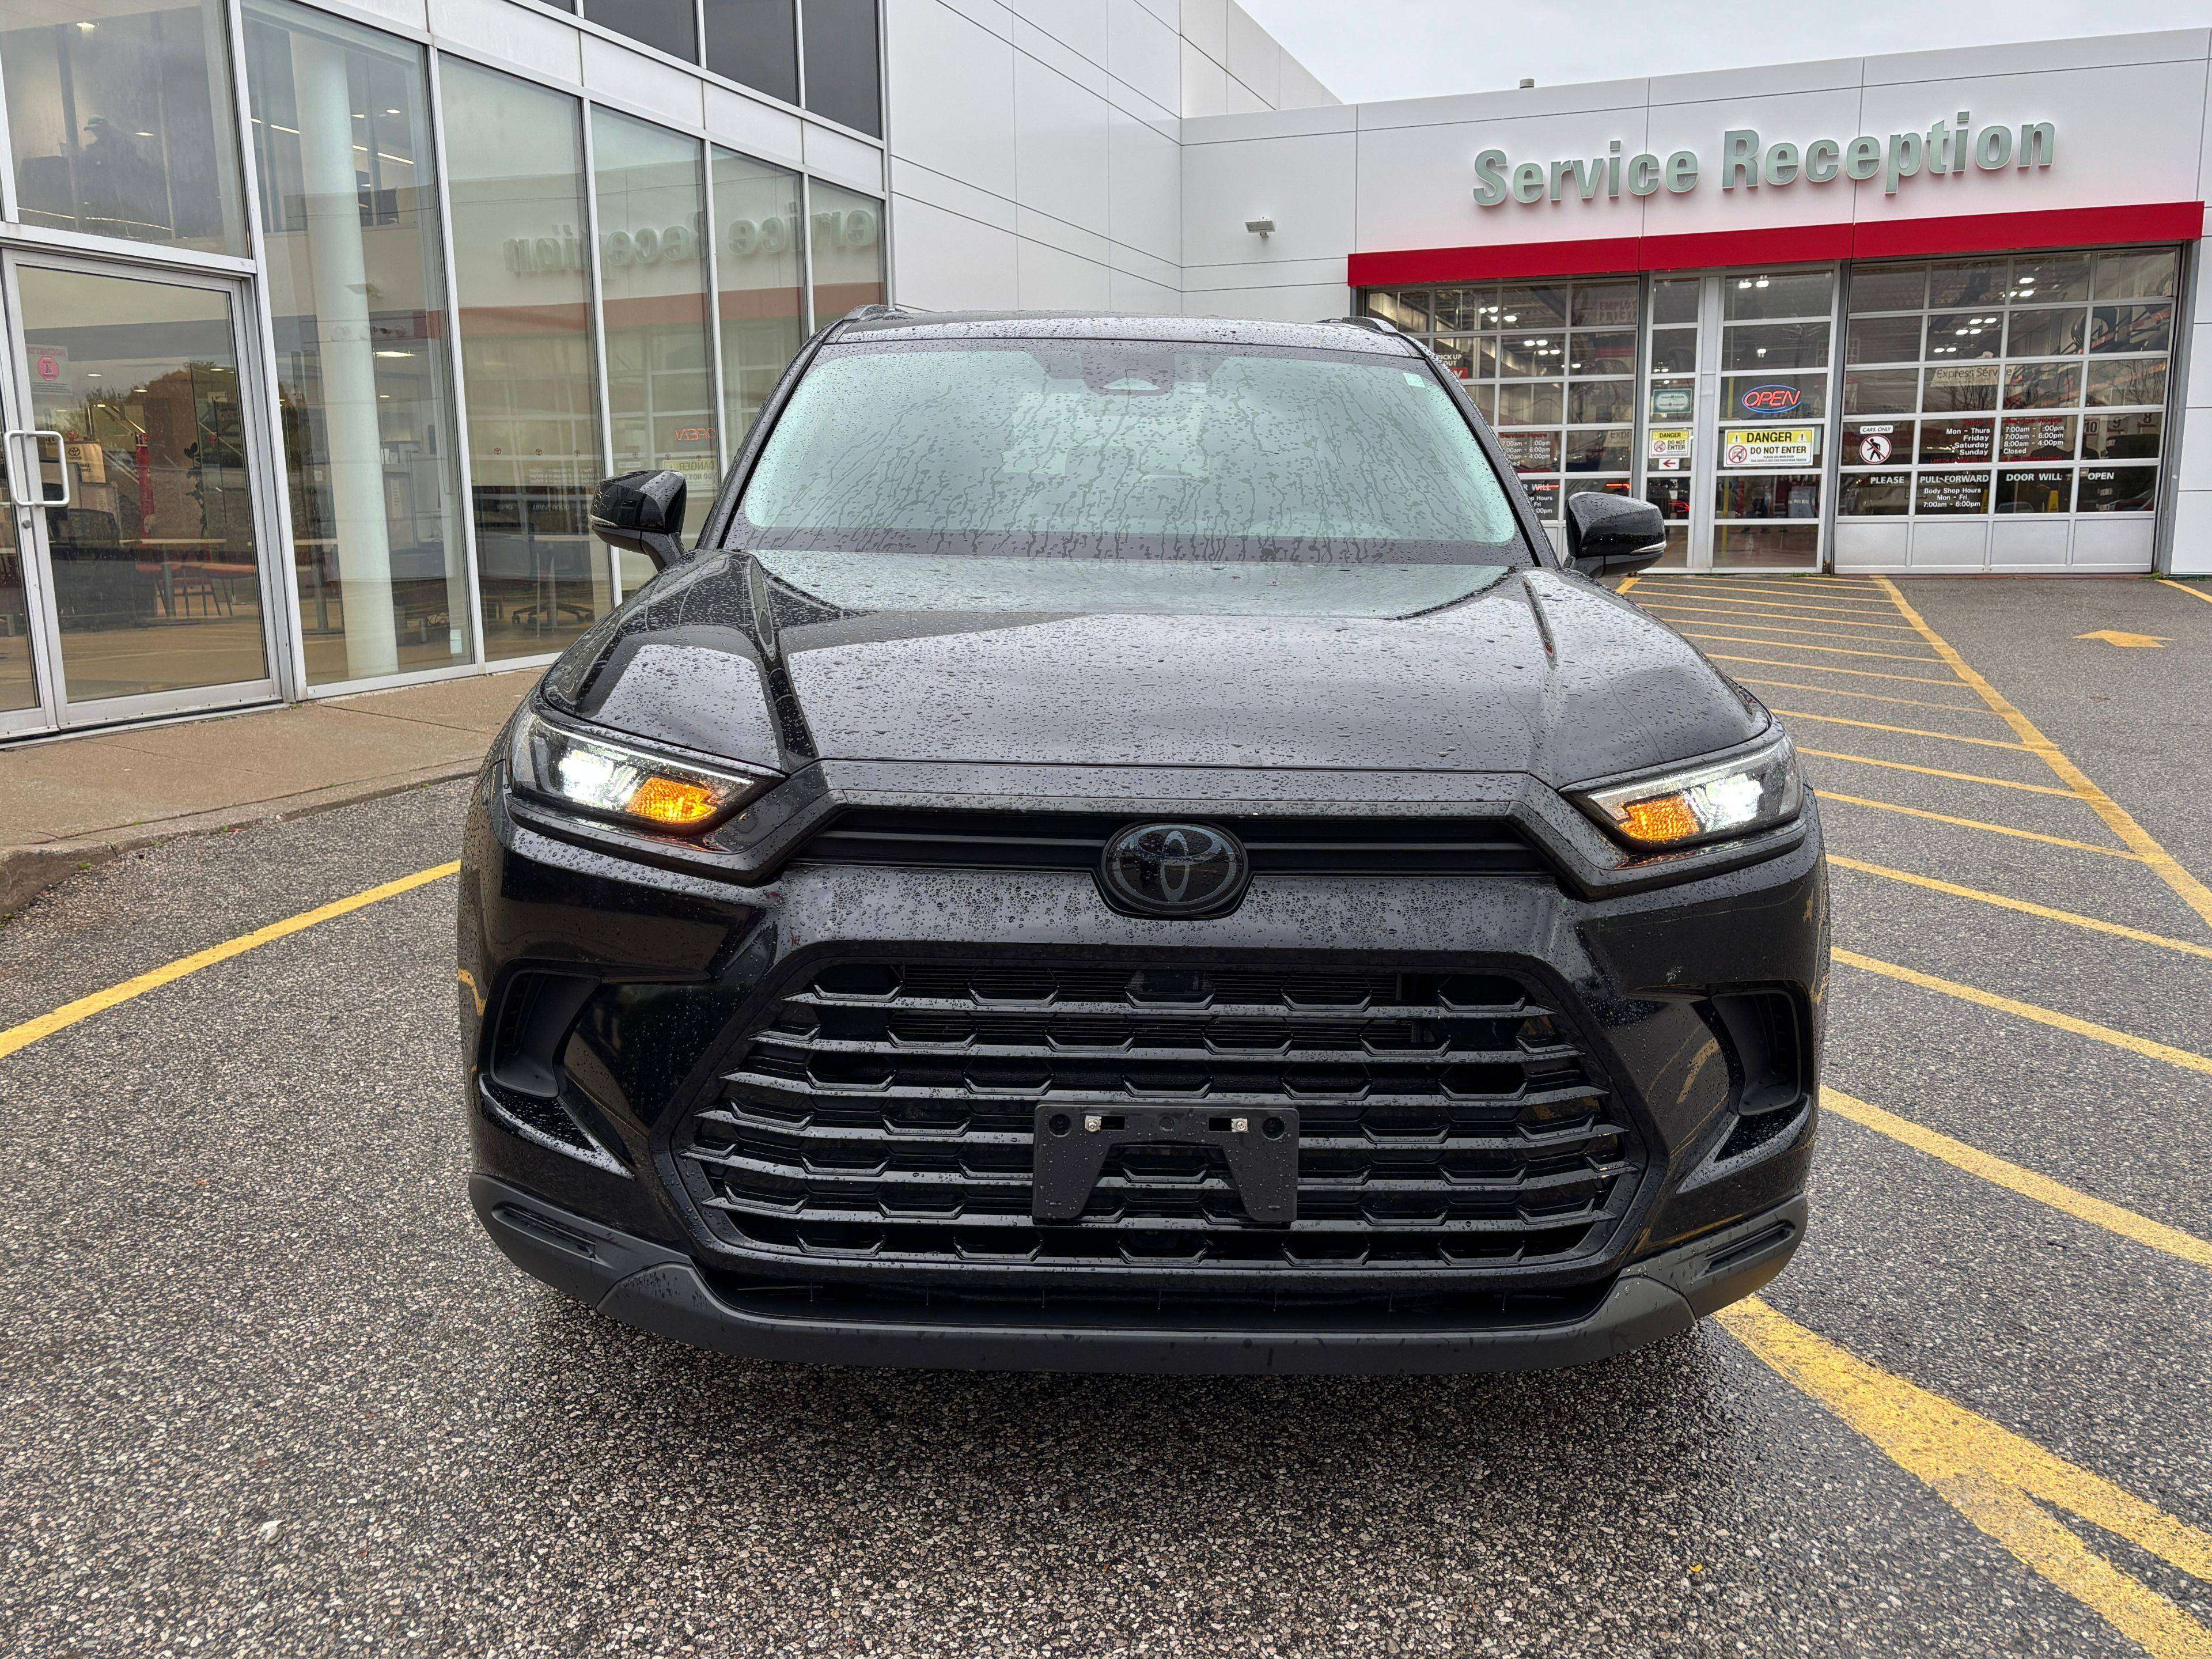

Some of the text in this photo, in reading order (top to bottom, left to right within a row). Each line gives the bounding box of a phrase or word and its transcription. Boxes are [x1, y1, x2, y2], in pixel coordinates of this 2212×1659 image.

[1473, 111, 2055, 206] Service Reception
[1937, 369, 1974, 380] Express
[1744, 391, 1801, 407] OPEN
[2085, 421, 2097, 433] 10
[1747, 431, 1792, 442] DANGER
[1750, 446, 1806, 454] DO NOT ENTER
[1870, 476, 1905, 484] PLEASE
[1944, 474, 1990, 483] FORWARD
[2006, 474, 2035, 482] DOOR
[2039, 473, 2062, 481] WILL
[2088, 472, 2115, 480] OPEN
